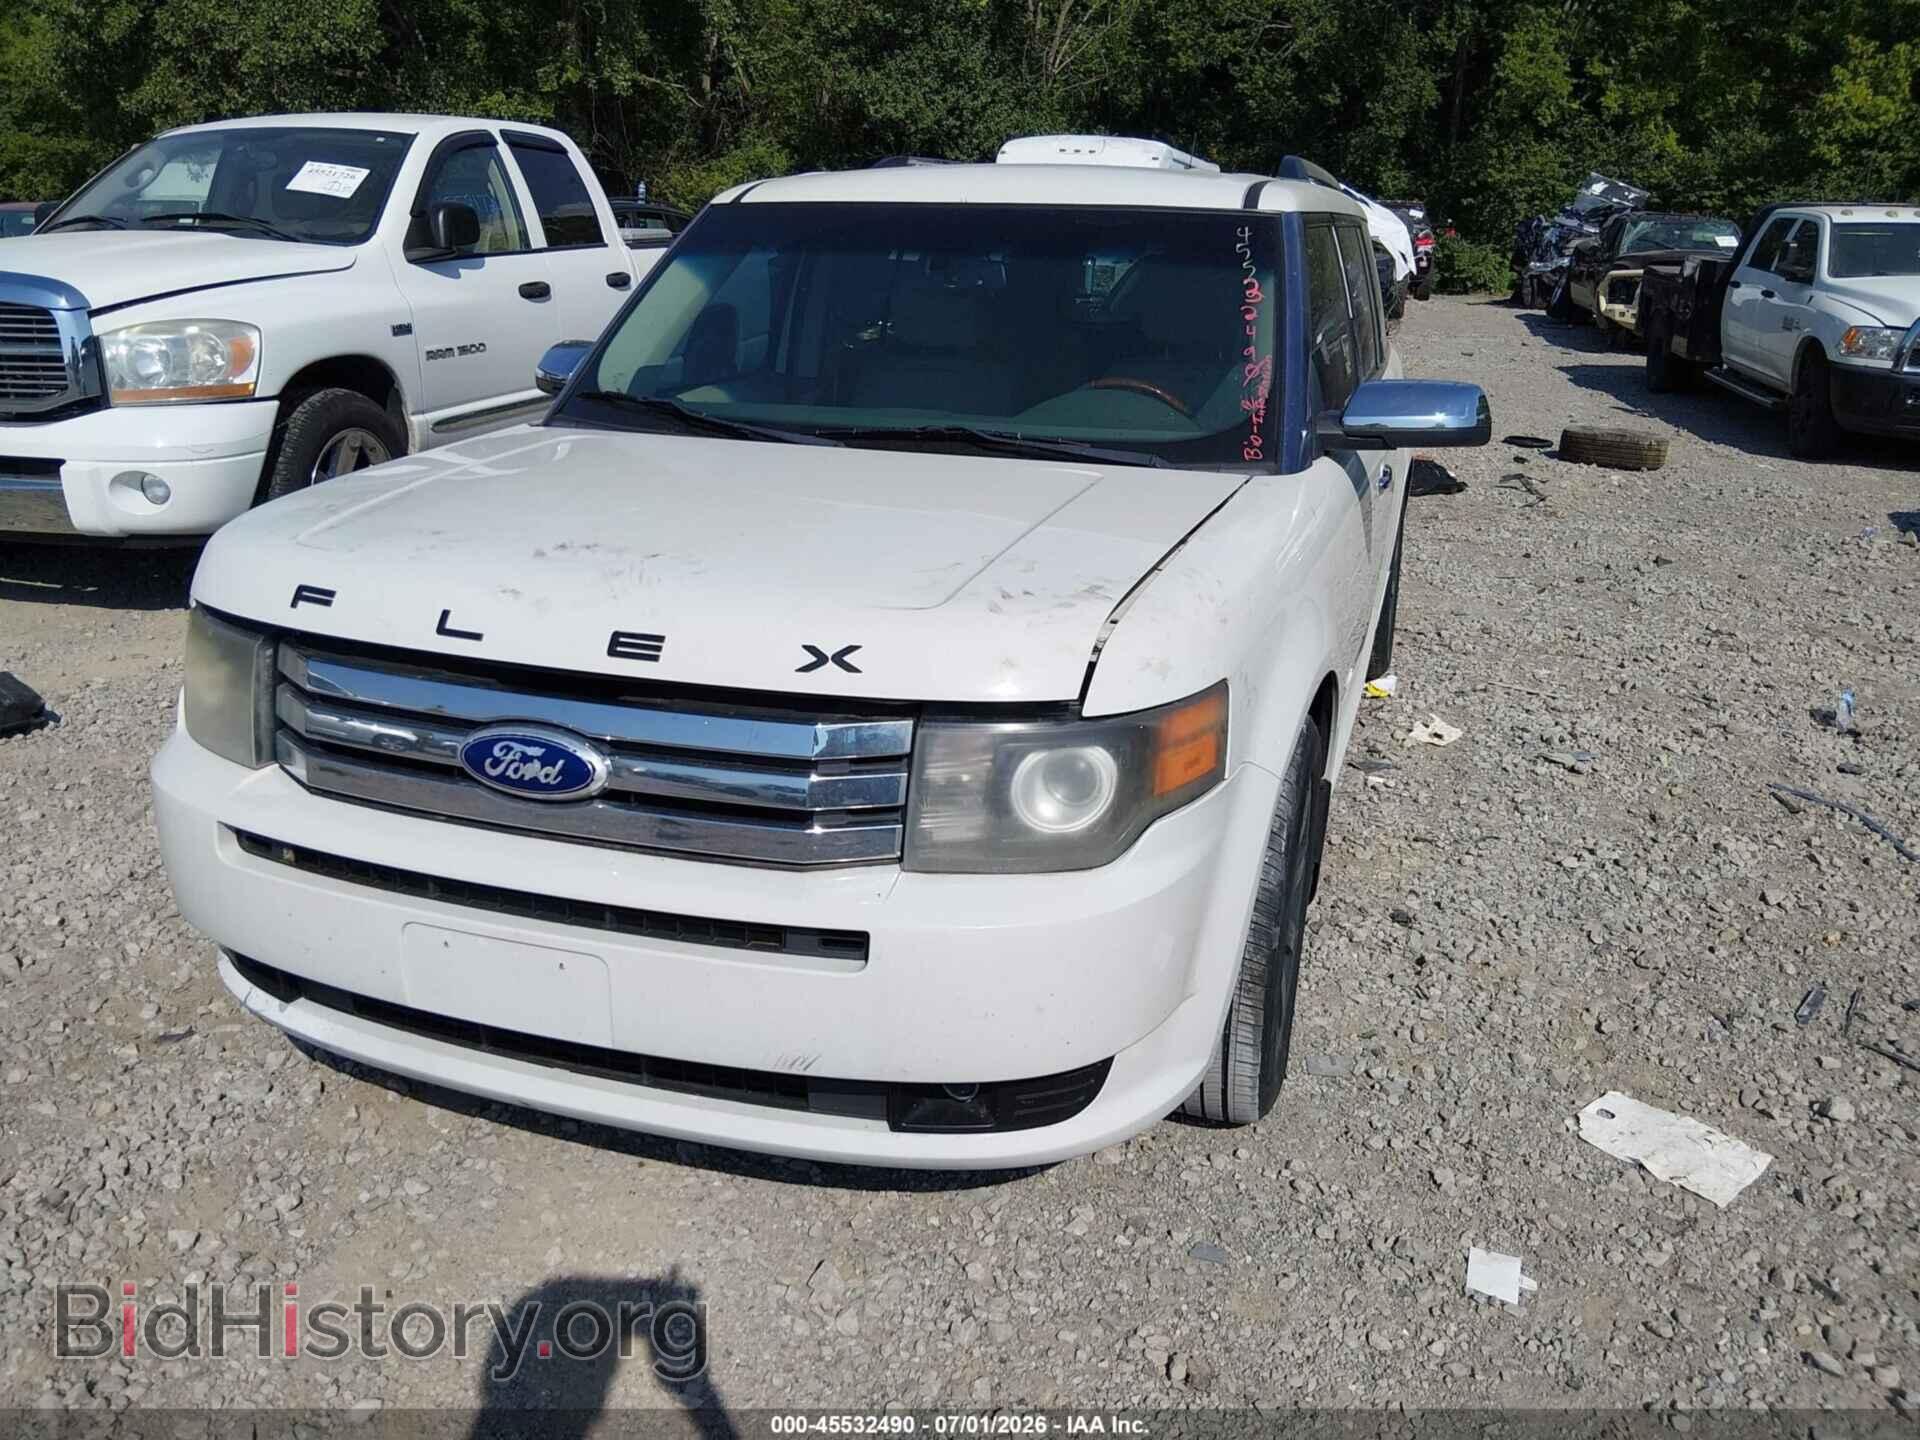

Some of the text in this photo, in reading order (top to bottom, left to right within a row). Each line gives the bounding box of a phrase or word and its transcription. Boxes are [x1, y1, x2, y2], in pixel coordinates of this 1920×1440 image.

[425, 342, 487, 361] RAM 1500
[290, 583, 862, 673] FLEX
[484, 741, 565, 785] Ford
